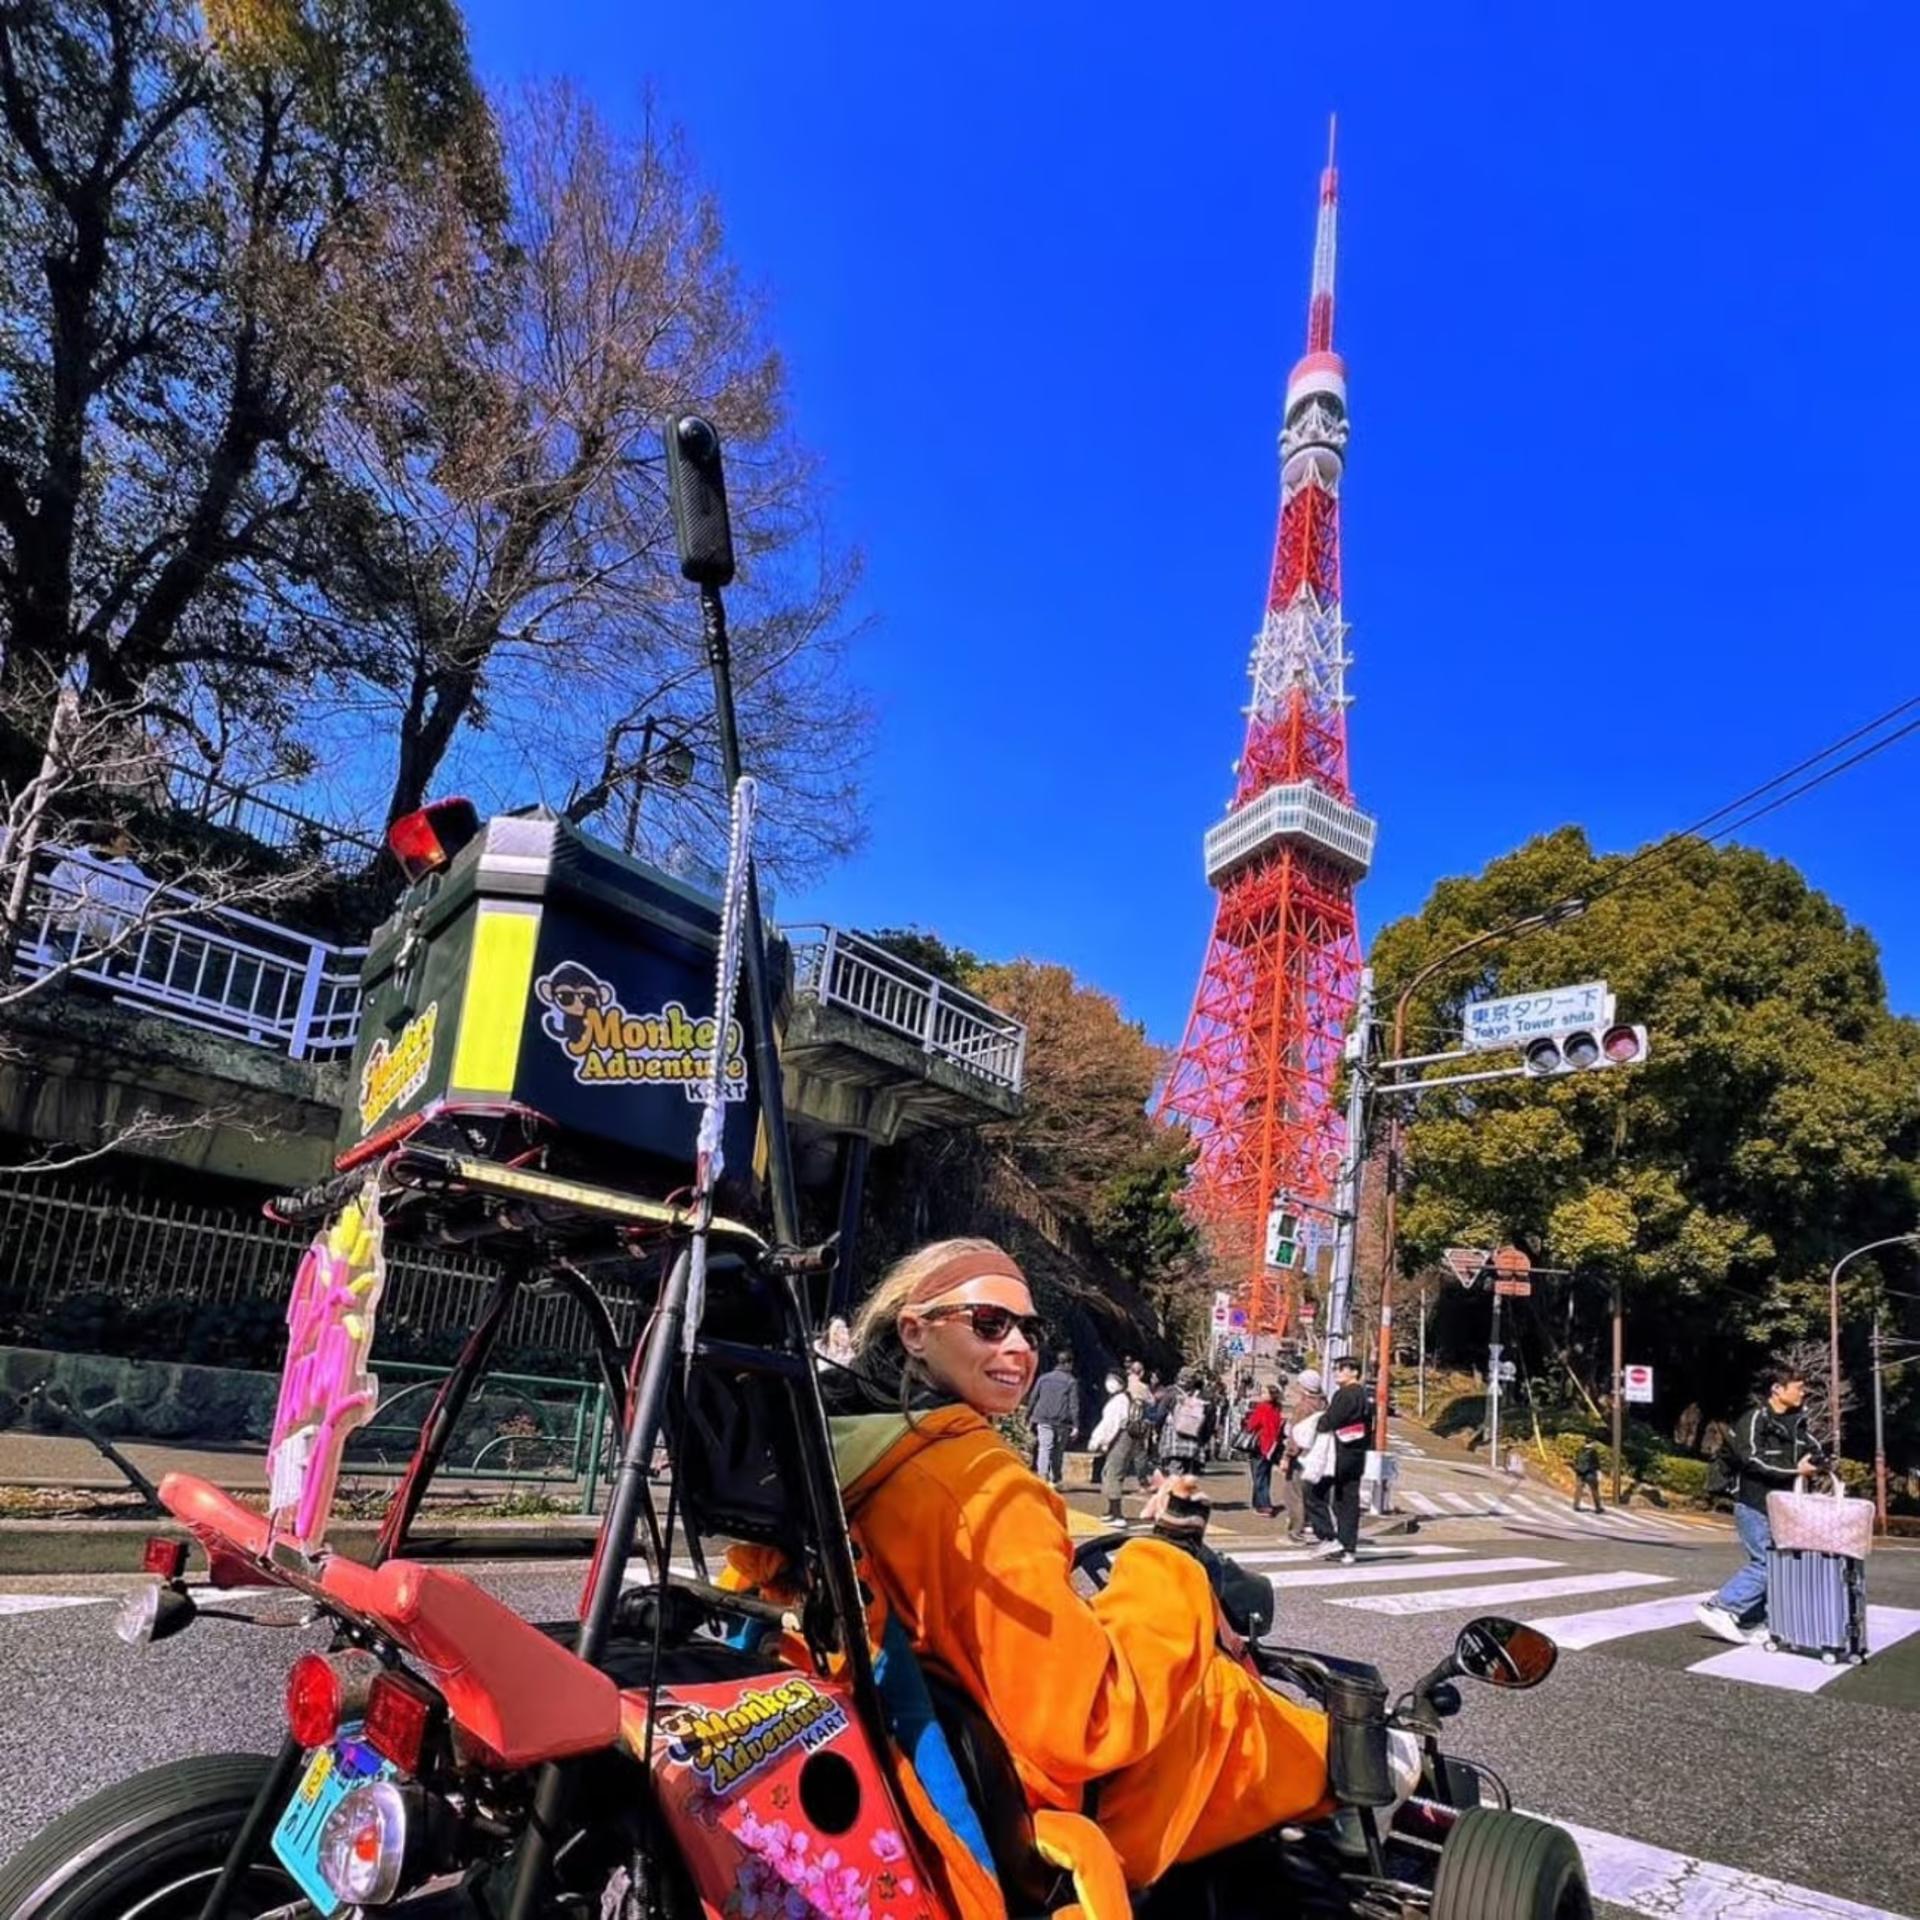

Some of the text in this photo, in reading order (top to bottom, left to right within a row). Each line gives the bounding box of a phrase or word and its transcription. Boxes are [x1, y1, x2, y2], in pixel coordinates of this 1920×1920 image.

[1472, 988, 1599, 1023] 東京タワー下
[1473, 1024, 1511, 1039] Tokyo
[1517, 1017, 1556, 1032] Tower
[580, 1051, 745, 1079] Adventue
[693, 1680, 815, 1770] Monkey
[713, 1695, 834, 1790] Adventure
[802, 1711, 847, 1749] KART
